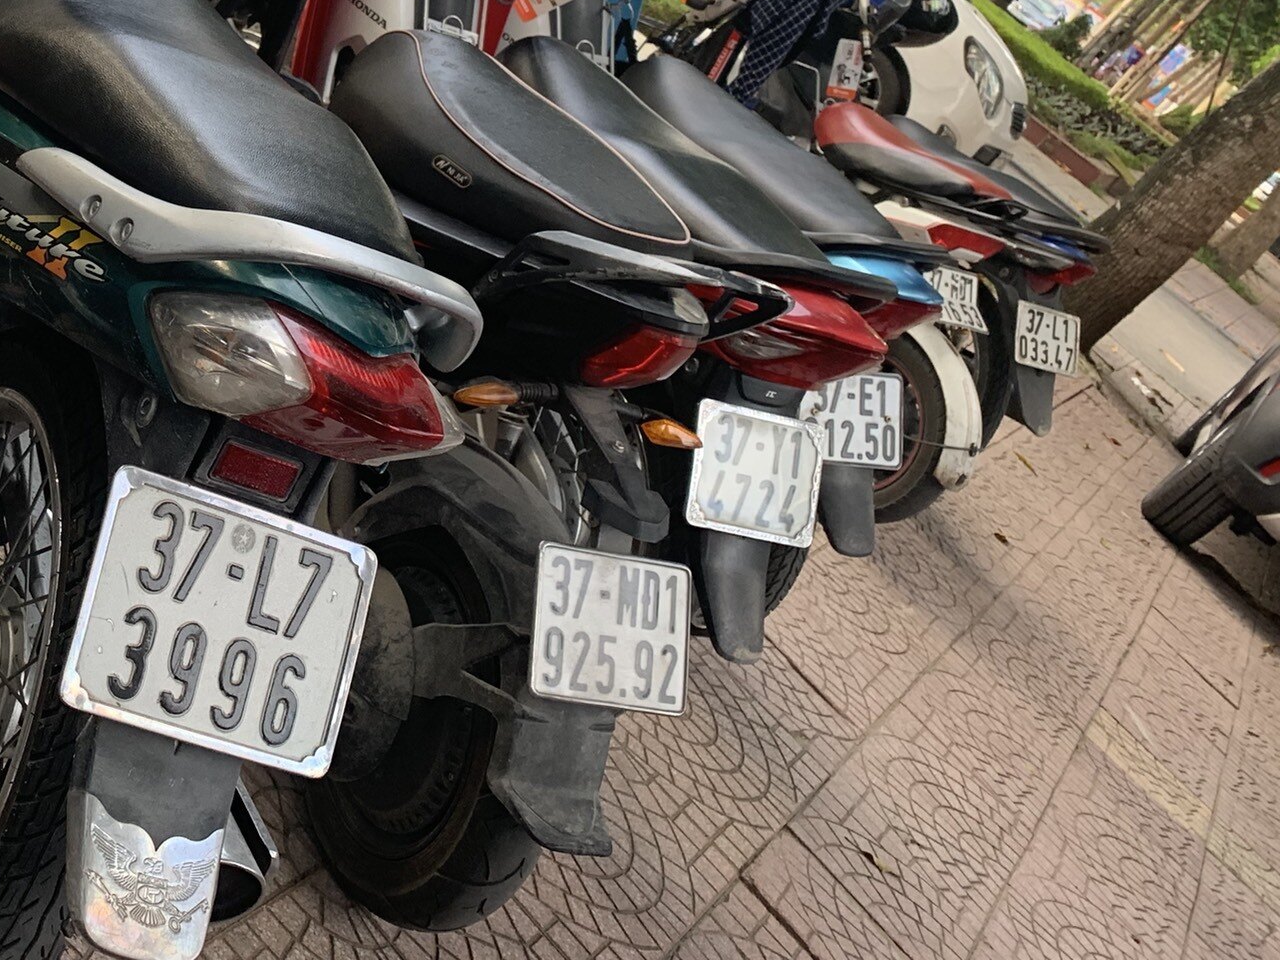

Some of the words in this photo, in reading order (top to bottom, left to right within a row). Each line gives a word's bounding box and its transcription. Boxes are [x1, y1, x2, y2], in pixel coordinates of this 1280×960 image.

[1019, 335, 1073, 372] 033.47
[1026, 309, 1068, 343] 37-L1
[814, 377, 887, 418] 37-E1
[714, 415, 803, 479] 37-Y1
[805, 416, 896, 462] 12.50
[707, 470, 795, 533] 4724
[138, 501, 333, 638] 37-L7
[107, 606, 306, 746] 3996
[542, 626, 679, 705] 925.92
